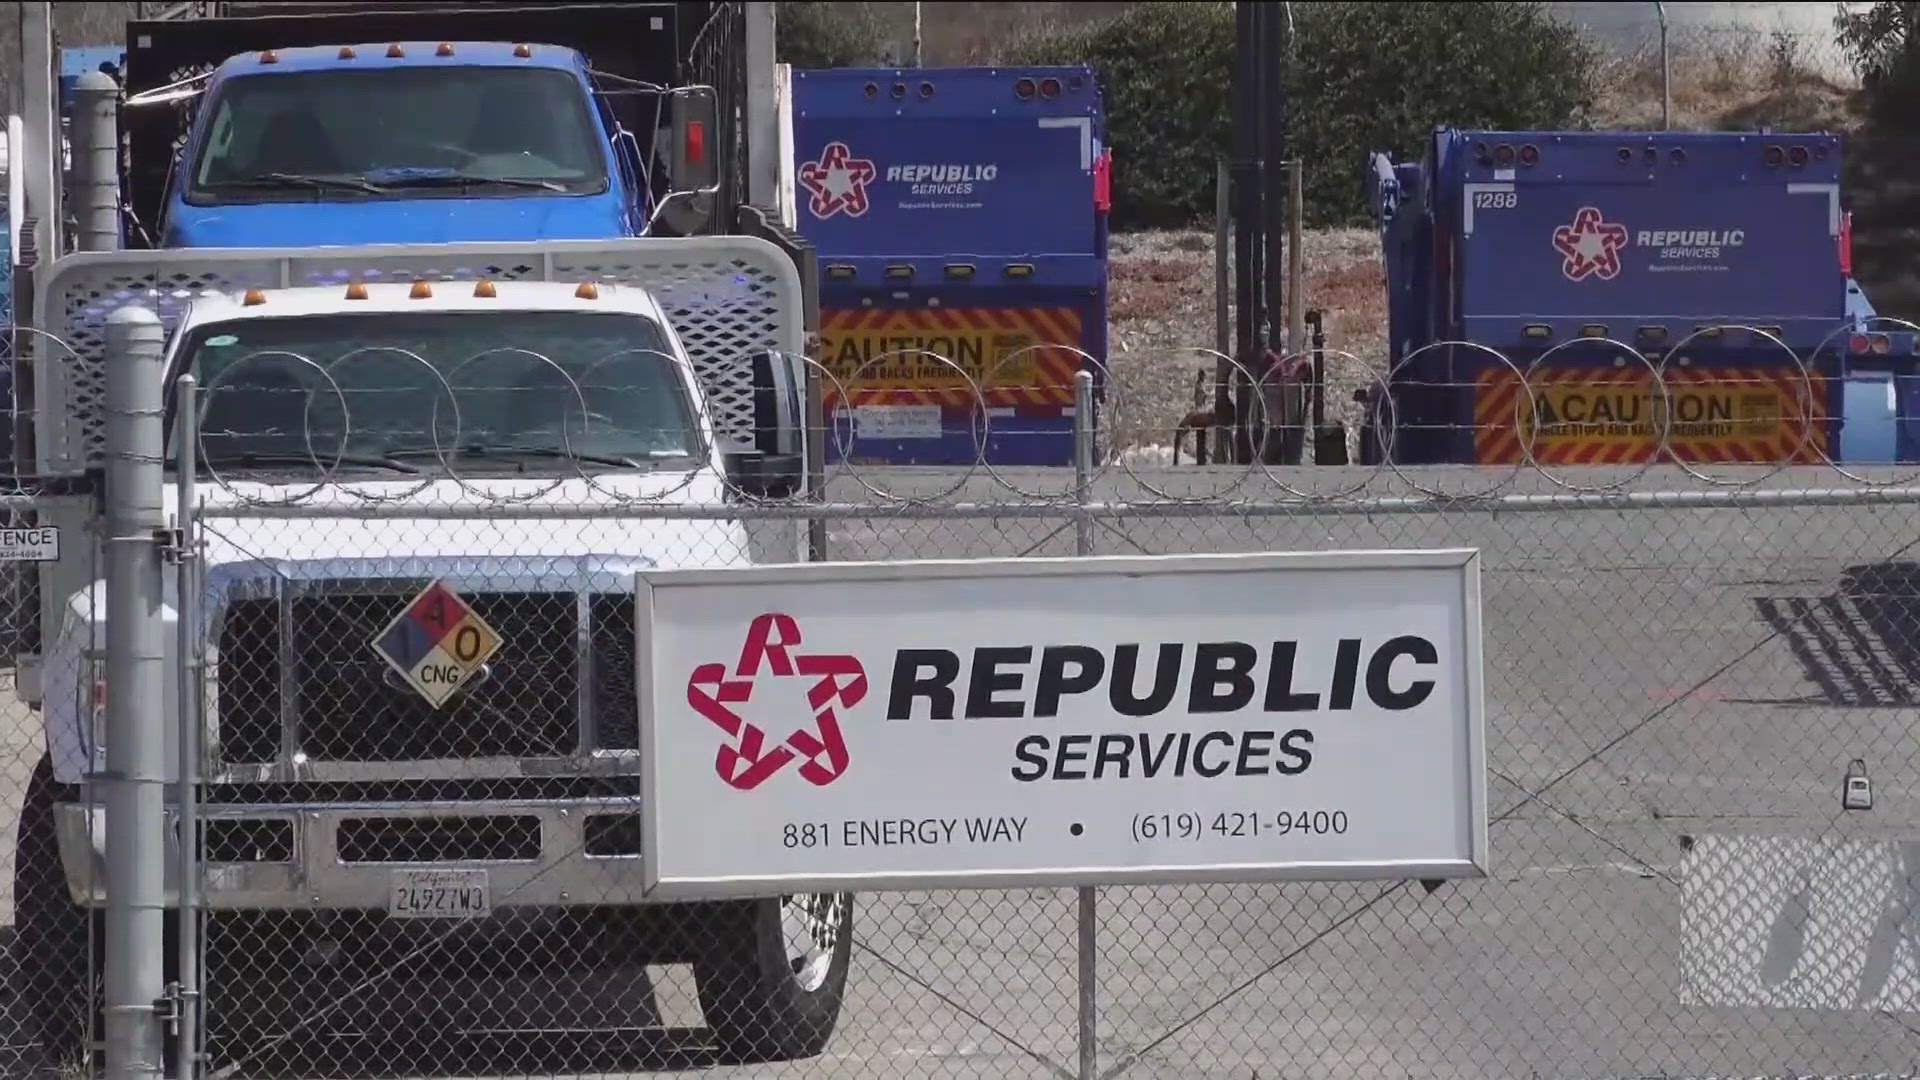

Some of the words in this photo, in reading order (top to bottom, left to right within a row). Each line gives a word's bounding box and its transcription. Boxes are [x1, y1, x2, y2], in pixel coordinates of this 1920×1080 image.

[887, 165, 997, 182] REPUBLIC
[912, 183, 973, 194] SERVICES
[1476, 193, 1517, 208] 1288
[1637, 230, 1744, 246] REPUBLIC
[1661, 247, 1720, 258] SERVICES
[1562, 394, 1731, 423] CAUTION
[455, 625, 481, 662] 0
[421, 664, 459, 684] CNG
[886, 635, 1438, 721] REPUBLIC
[1011, 729, 1314, 782] SERVICES
[783, 823, 829, 848] 881
[843, 819, 957, 846] ENERGY
[964, 817, 1028, 843] WAY
[1132, 812, 1202, 842] (619)
[1211, 811, 1348, 837] 421-9400
[397, 887, 483, 910] 24927W3
